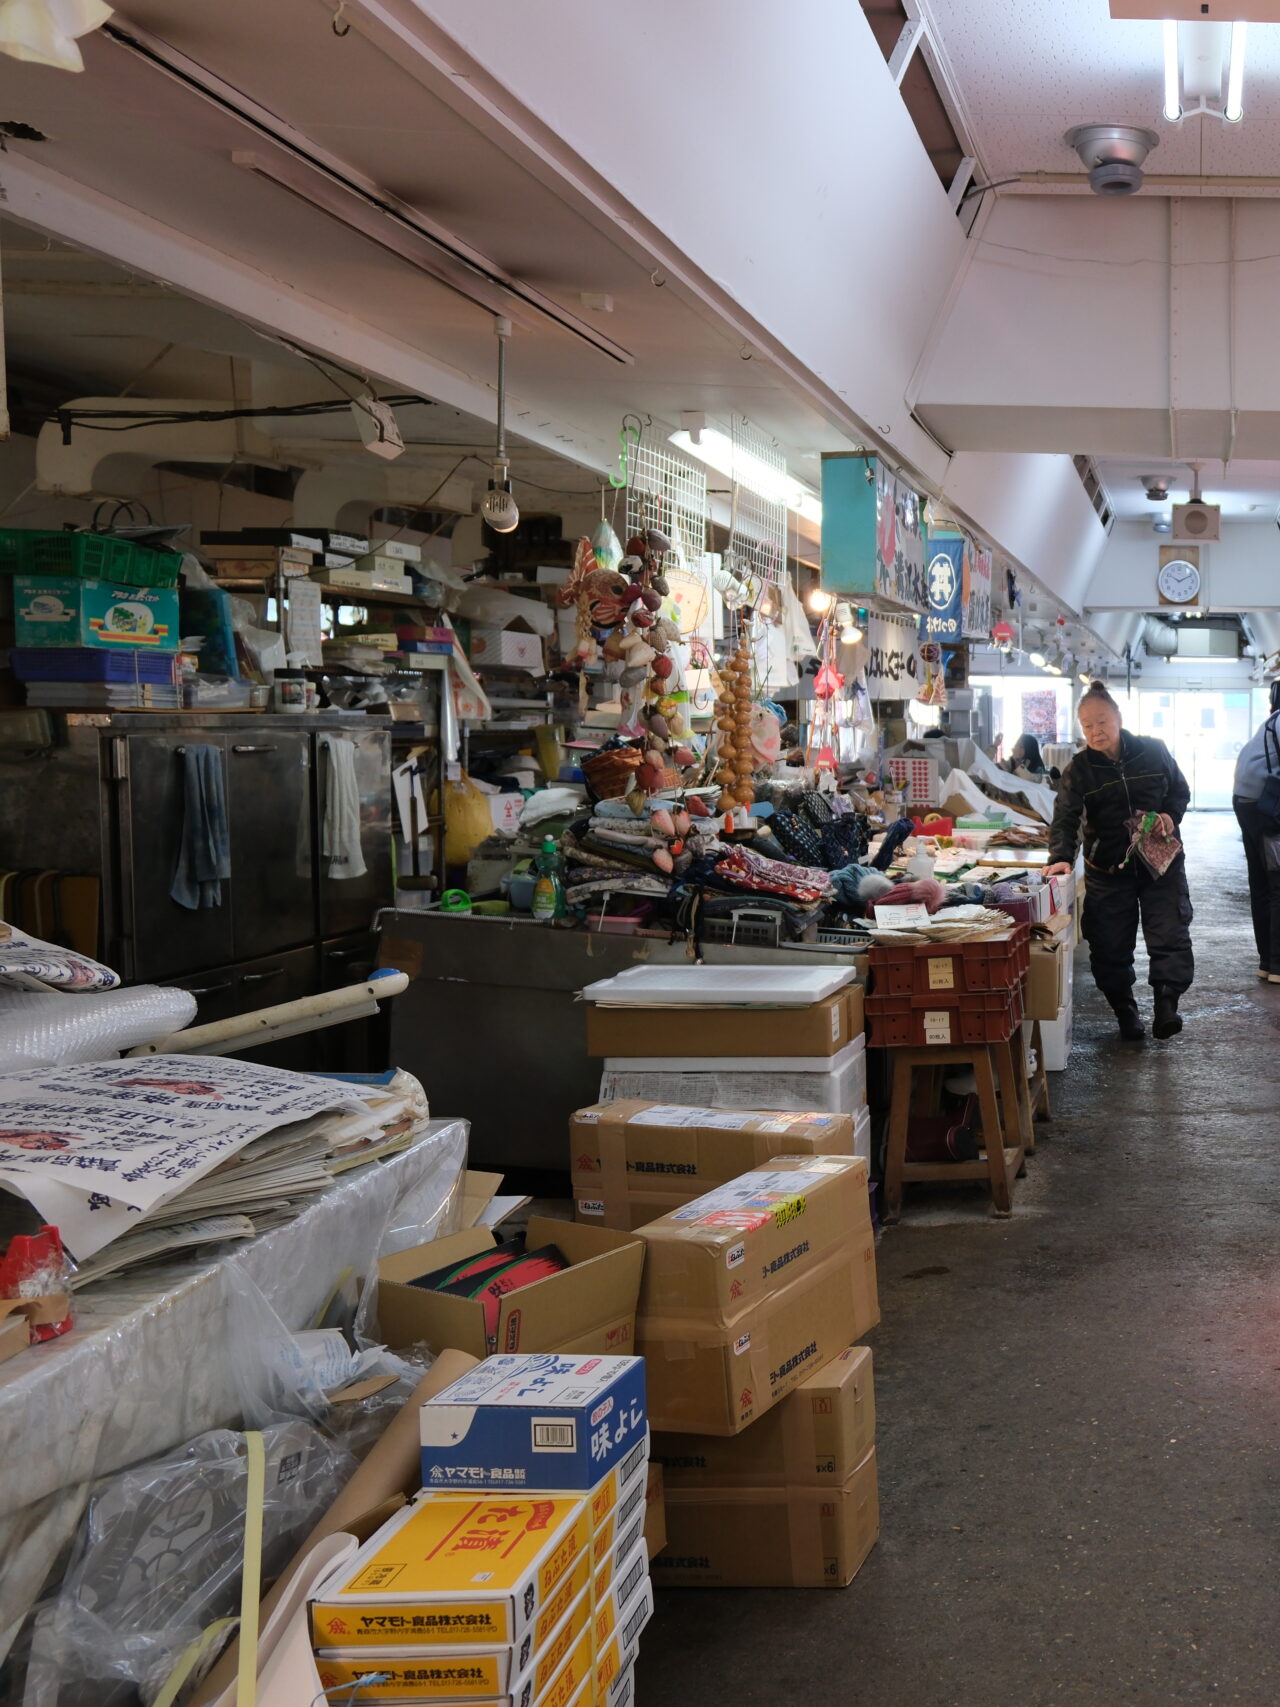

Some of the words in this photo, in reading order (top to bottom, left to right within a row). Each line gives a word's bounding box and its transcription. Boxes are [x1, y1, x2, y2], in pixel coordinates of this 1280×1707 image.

[361, 1614, 492, 1628] ヤマモト食品株式会社
